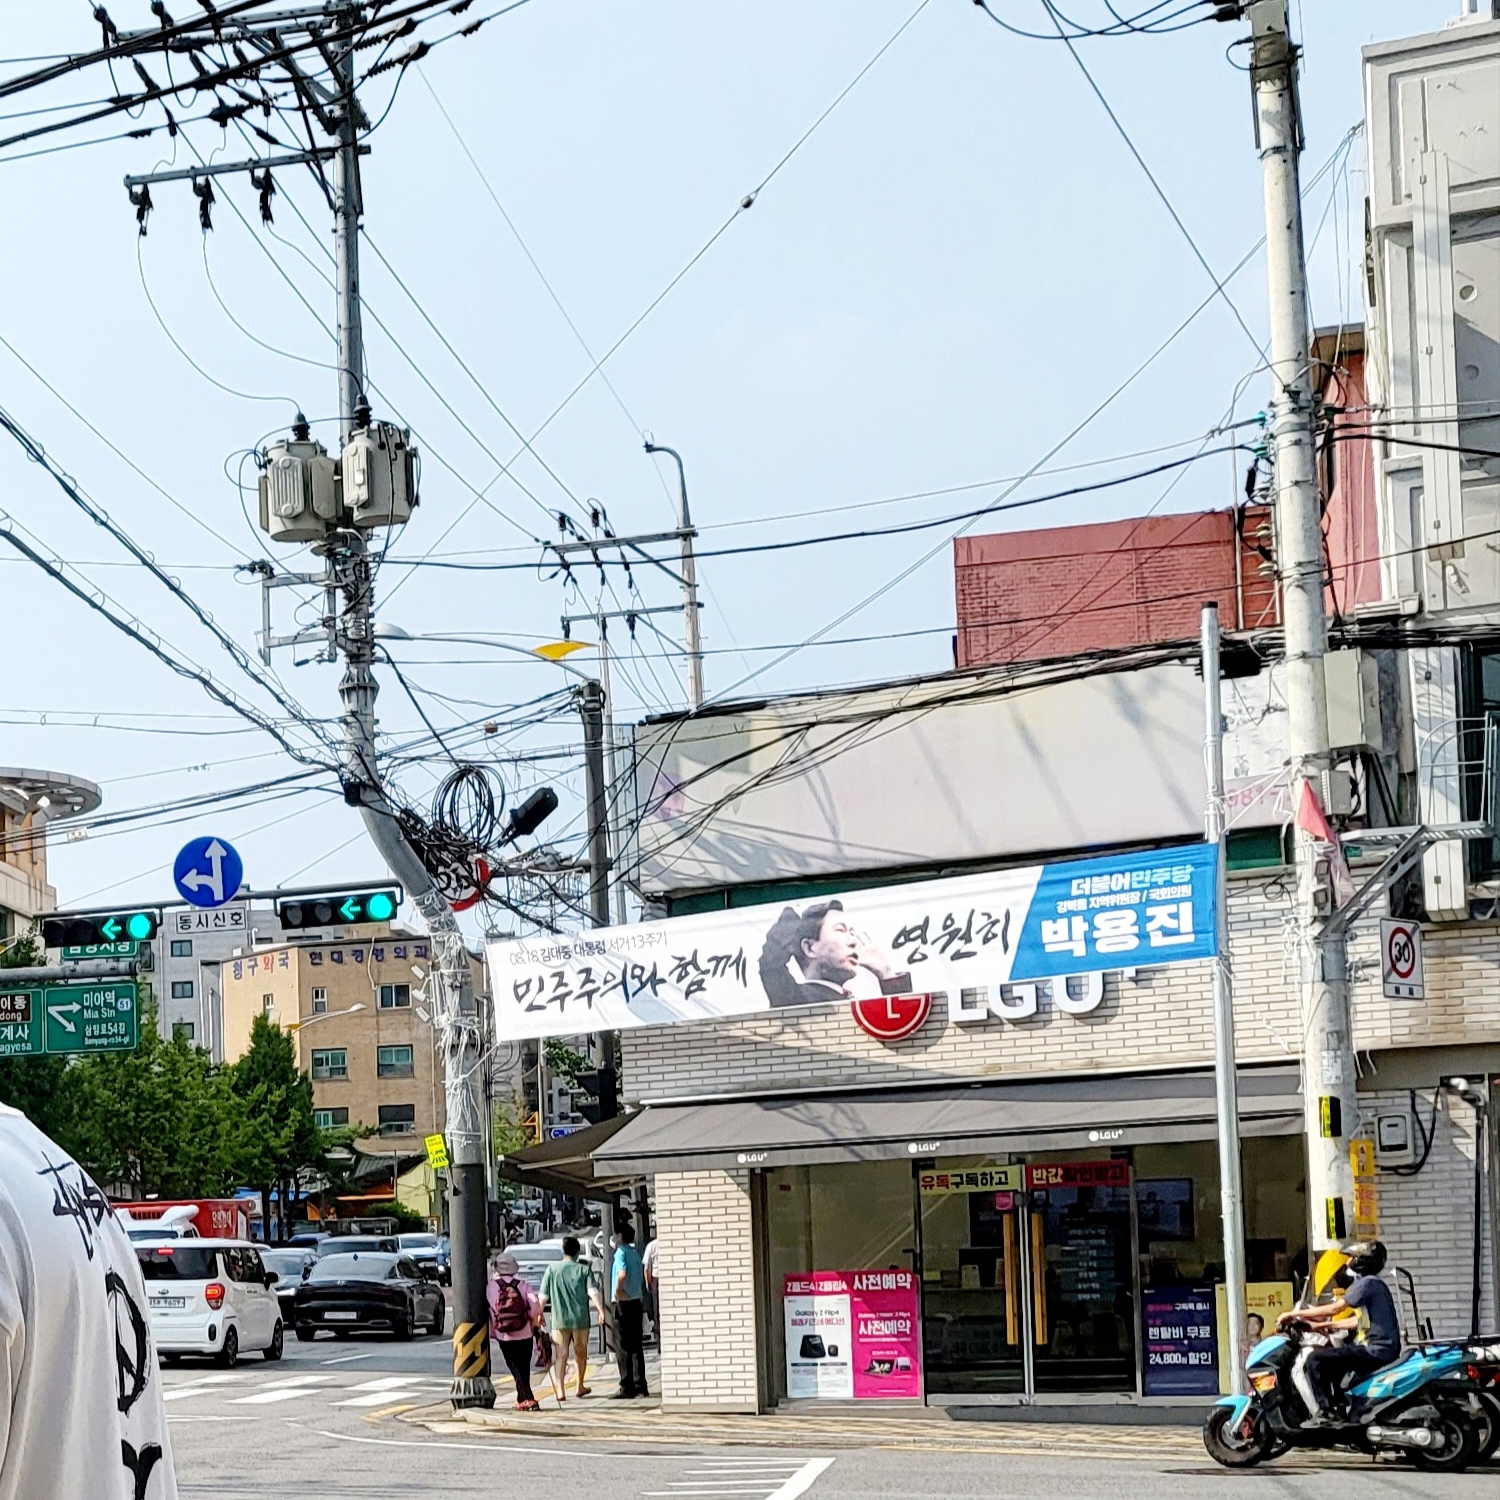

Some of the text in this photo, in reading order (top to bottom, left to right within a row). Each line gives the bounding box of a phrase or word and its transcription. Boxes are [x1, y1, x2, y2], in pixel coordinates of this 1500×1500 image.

[1071, 864, 1195, 896] 더불어민주당
[1089, 890, 1141, 909] 지역위원장
[1149, 884, 1192, 901] 국회의원
[179, 912, 244, 930] 동시신호
[1041, 901, 1196, 957] 박용진
[513, 907, 1011, 1013] 민주주의와 함께 영원히
[540, 944, 572, 963] 김대중
[574, 939, 607, 957] 대통령
[1395, 941, 1411, 963] 30
[83, 991, 116, 1008] 미아역
[119, 1000, 130, 1009] 51
[83, 1009, 100, 1019] Mia
[853, 1273, 912, 1291] 사전예약
[859, 1319, 912, 1335] 사전예약
[1187, 1326, 1211, 1338] 무료
